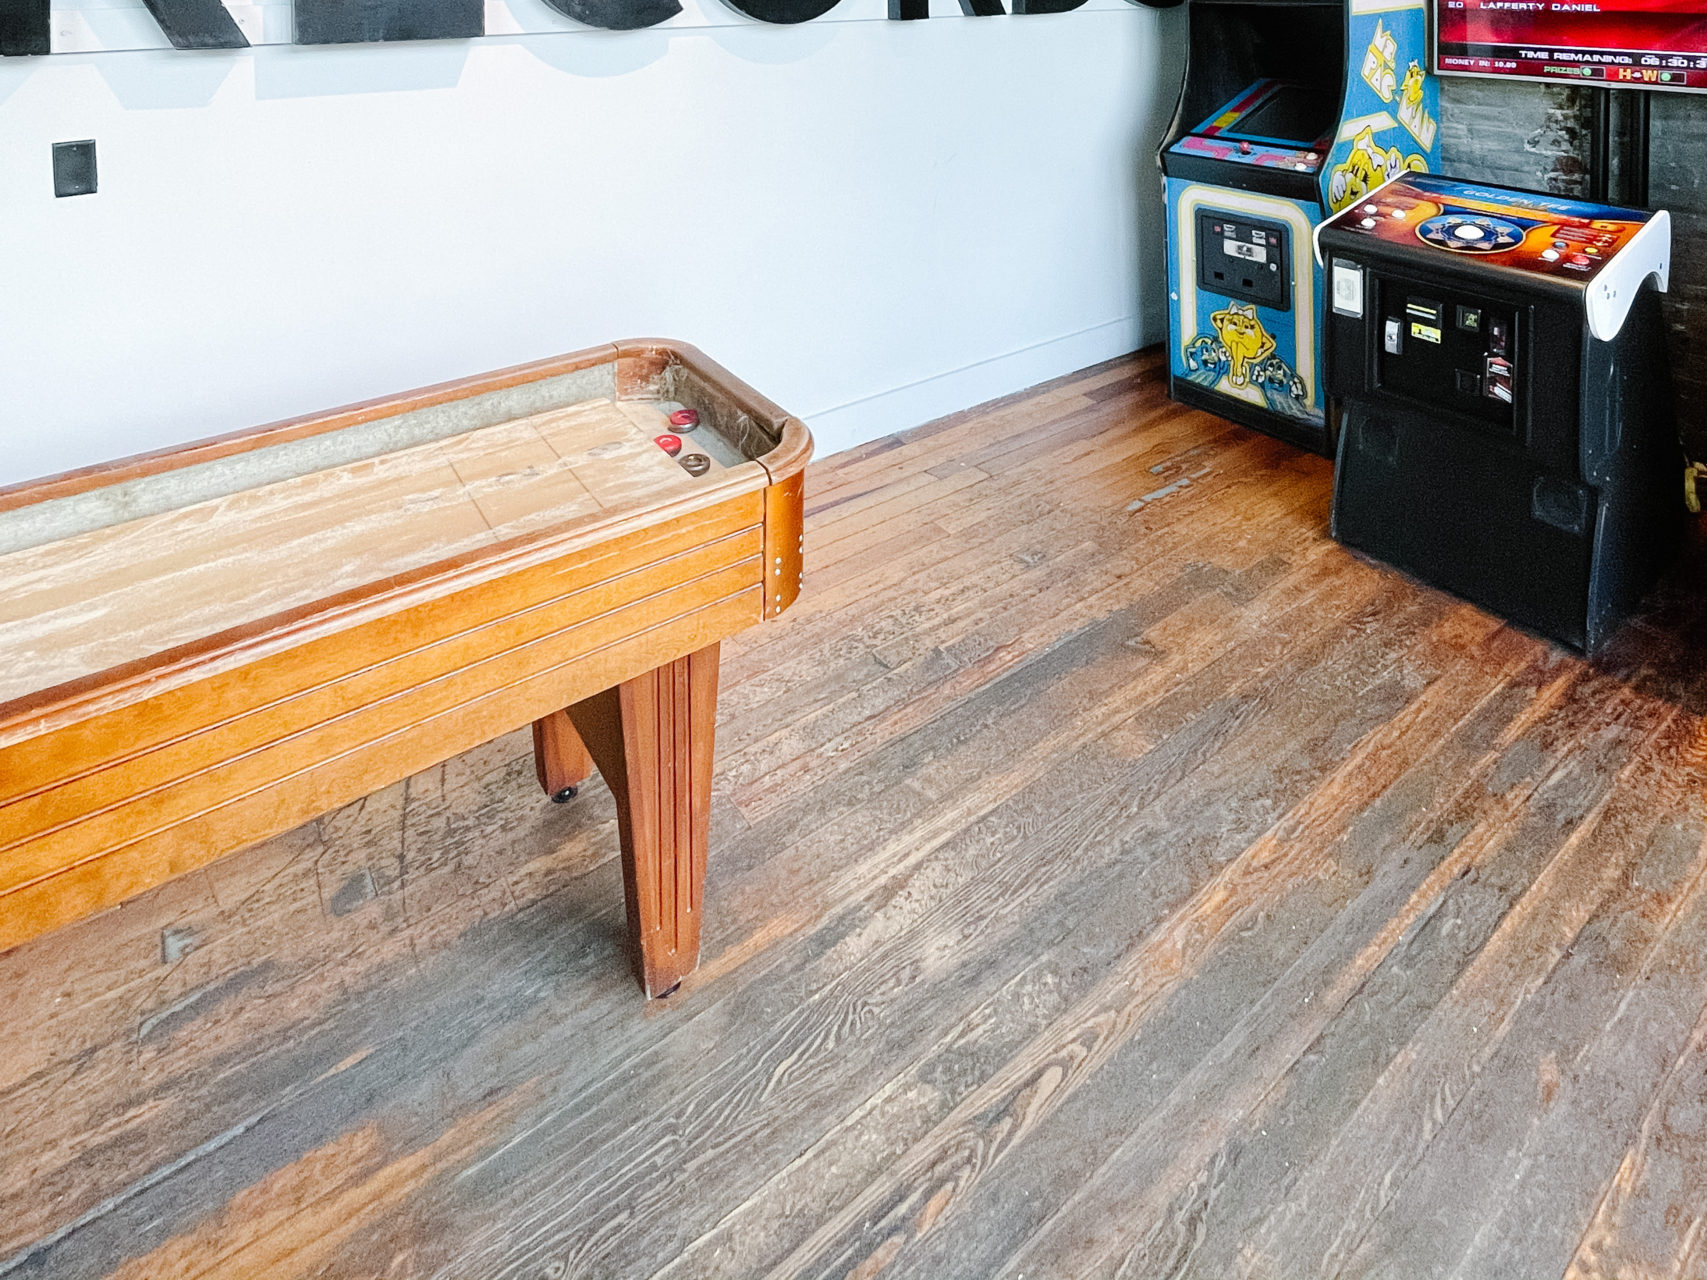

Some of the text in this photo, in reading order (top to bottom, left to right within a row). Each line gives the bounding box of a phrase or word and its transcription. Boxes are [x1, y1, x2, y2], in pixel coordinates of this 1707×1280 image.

[1480, 2, 1545, 10] LAFFERTY
[1551, 3, 1601, 12] DANIEL
[1519, 50, 1549, 59] TIME
[1553, 52, 1632, 64] REMAINING:
[1444, 58, 1475, 66] MONEY
[1543, 66, 1580, 75] PRIZES
